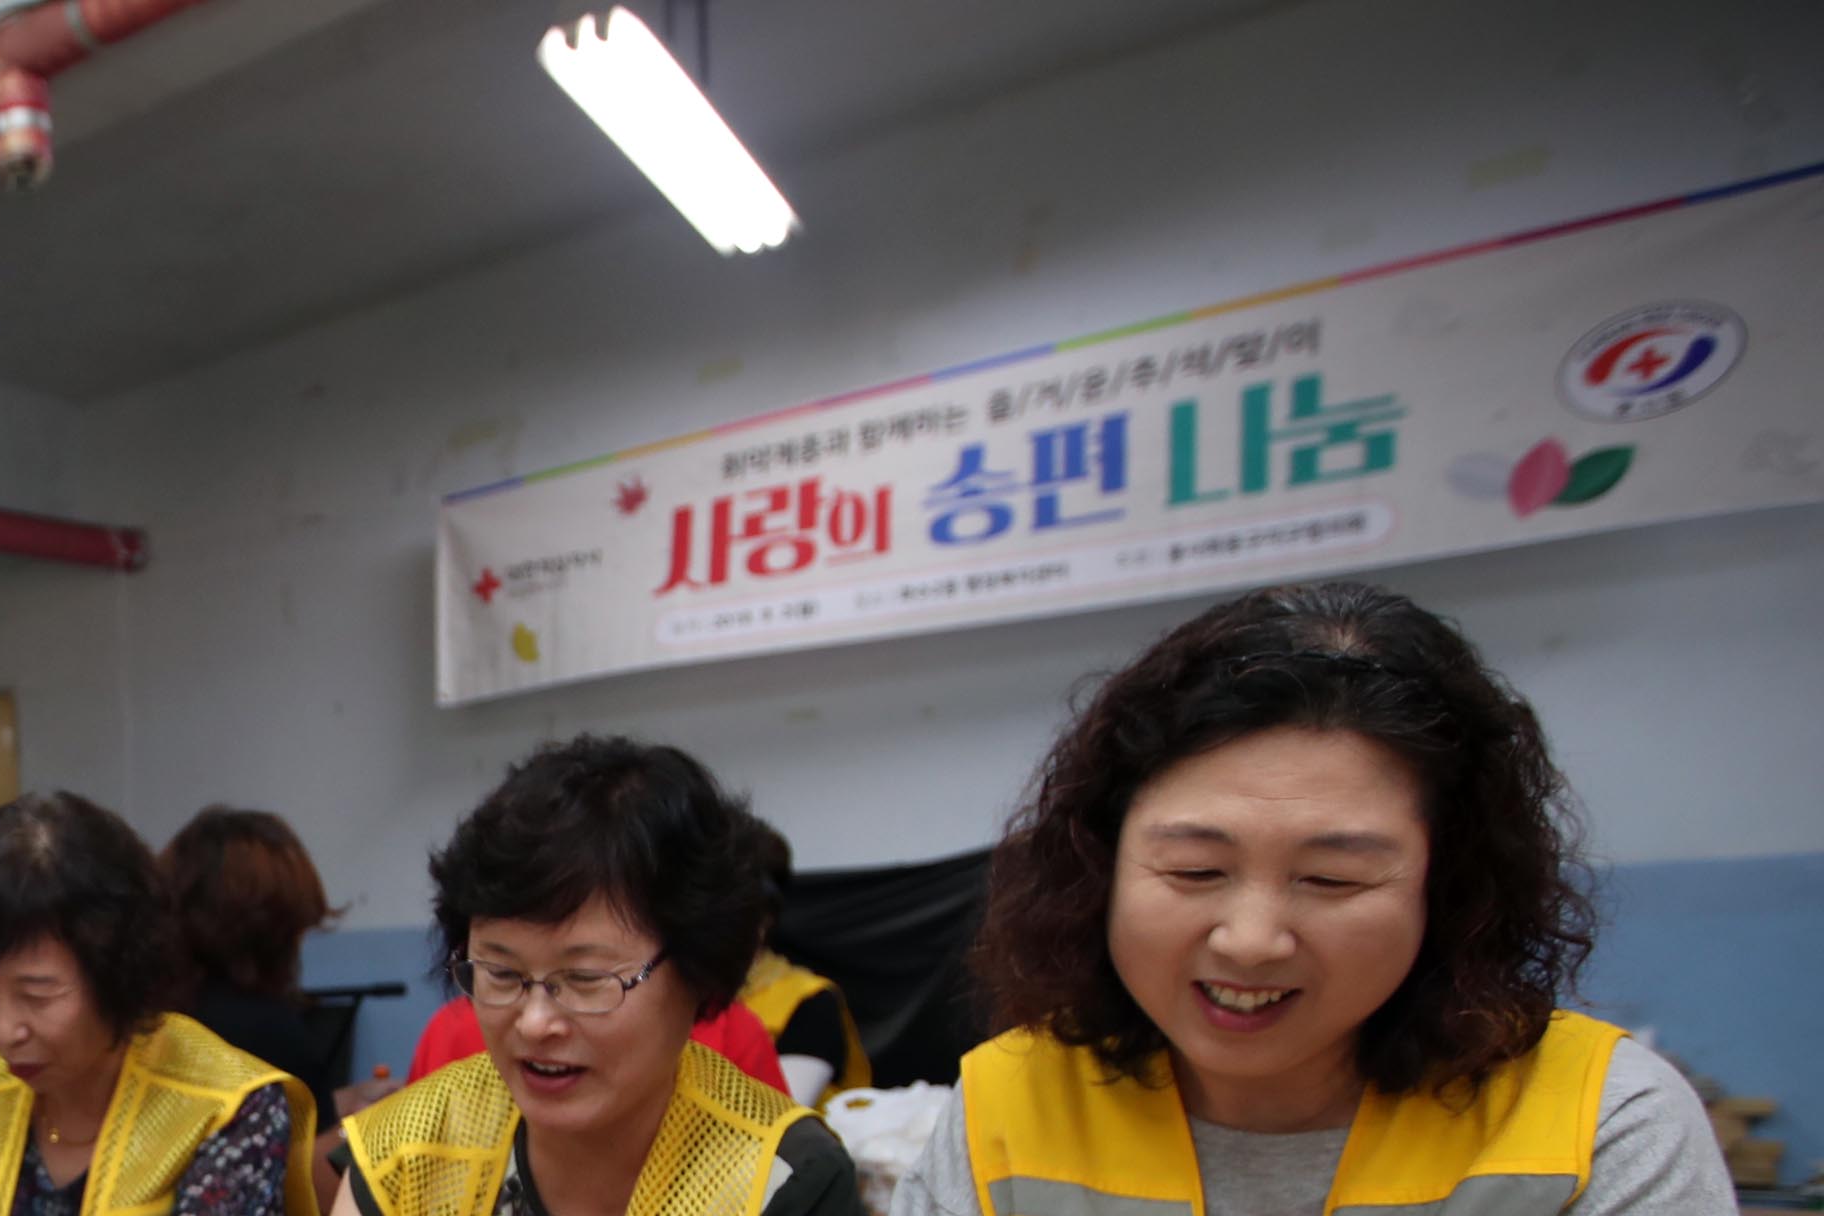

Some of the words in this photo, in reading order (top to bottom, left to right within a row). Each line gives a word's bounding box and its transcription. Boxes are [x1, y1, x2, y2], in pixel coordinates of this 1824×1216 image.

[651, 476, 893, 599] 사랑의
[922, 409, 1133, 548] 송편
[1164, 371, 1408, 508] 나눔
